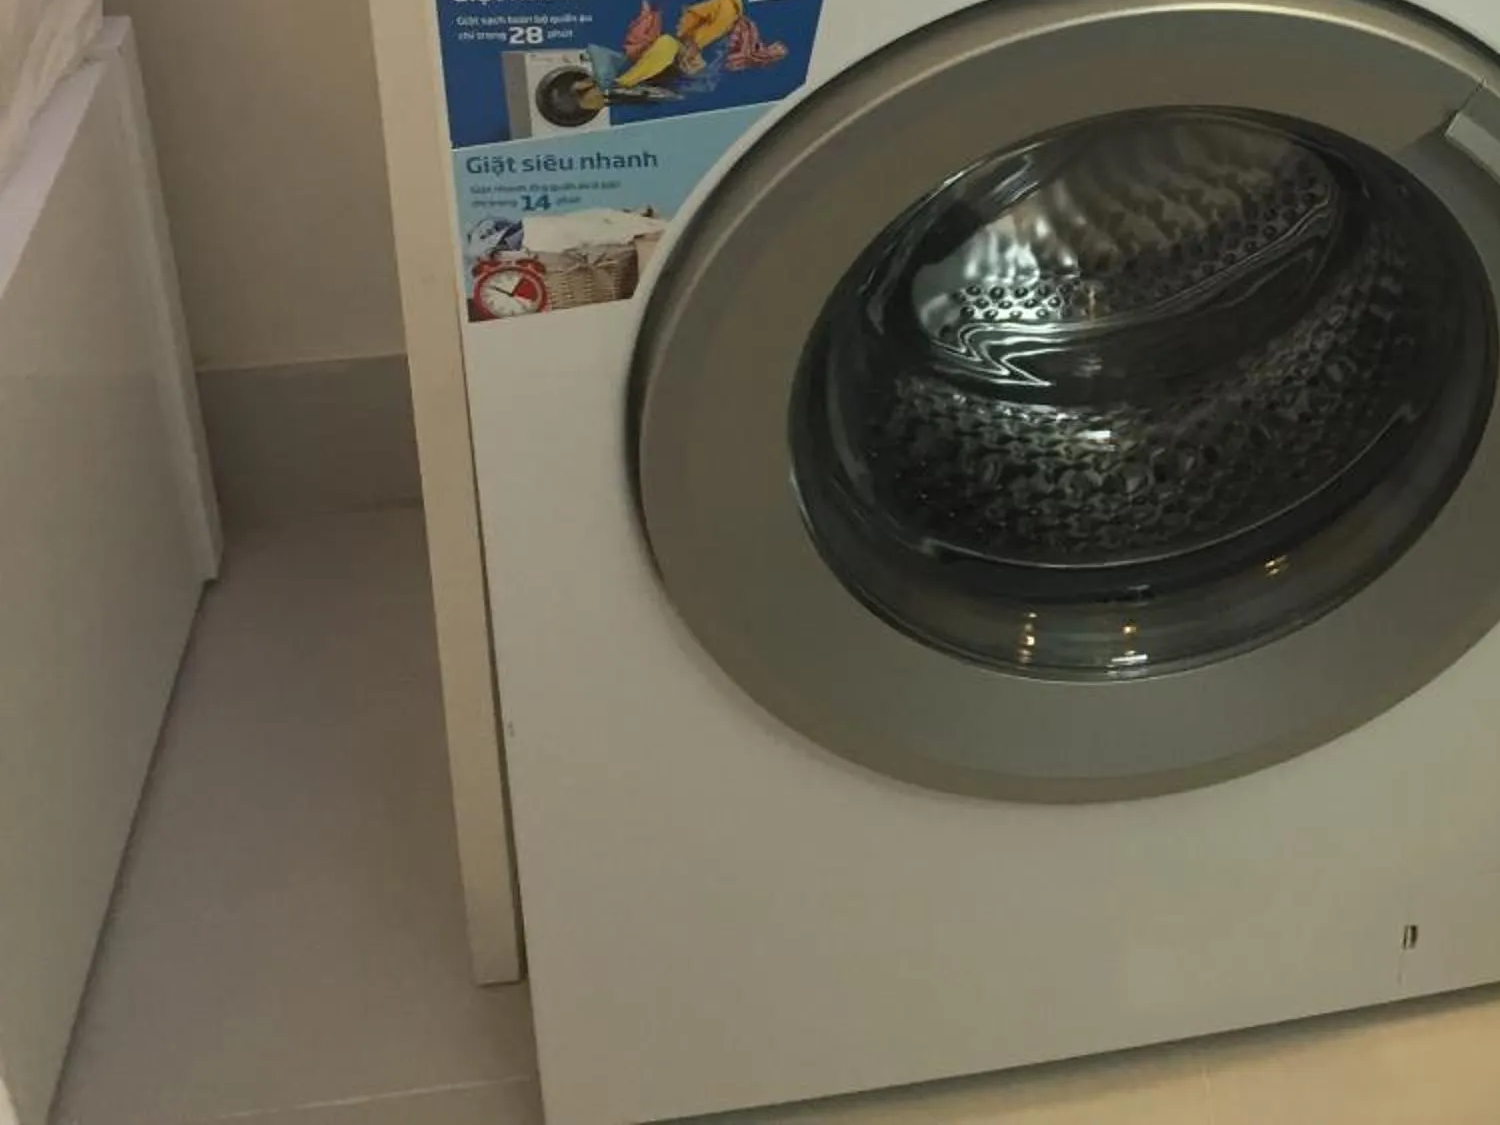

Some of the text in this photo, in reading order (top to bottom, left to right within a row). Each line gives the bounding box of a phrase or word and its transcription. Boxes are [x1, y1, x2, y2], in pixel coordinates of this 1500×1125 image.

[508, 26, 544, 44] 28
[466, 150, 660, 176] Giặt siêu nhanh
[521, 194, 551, 212] 14
